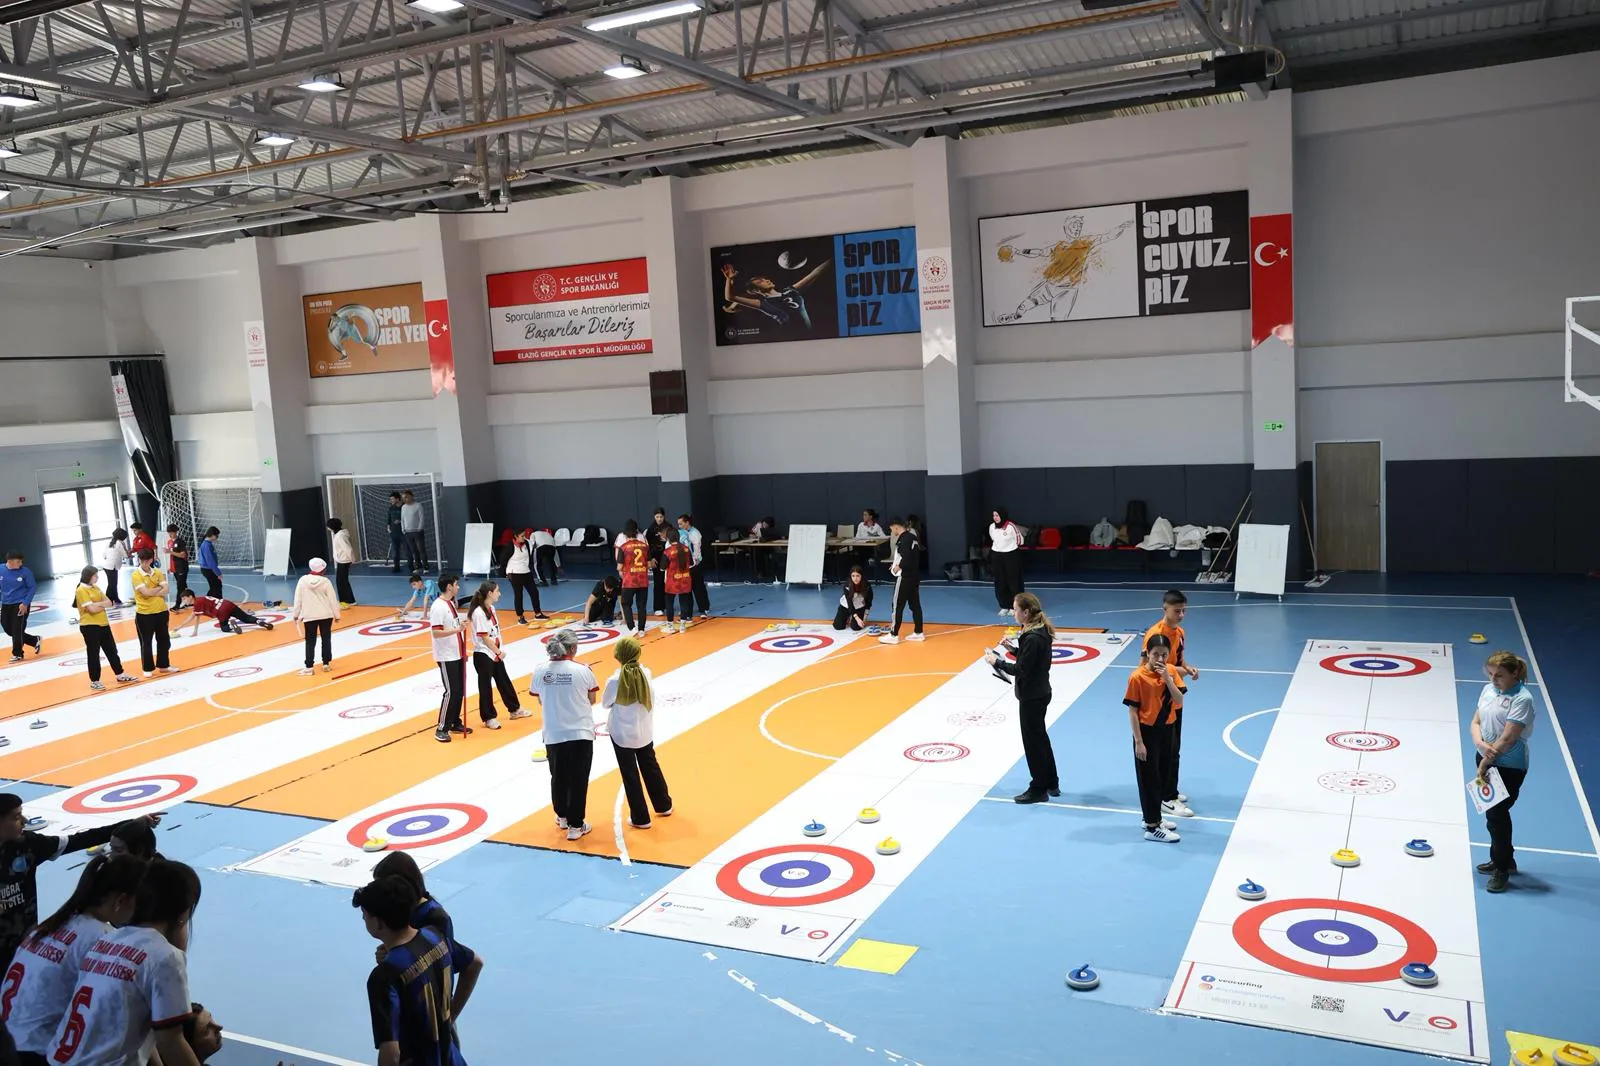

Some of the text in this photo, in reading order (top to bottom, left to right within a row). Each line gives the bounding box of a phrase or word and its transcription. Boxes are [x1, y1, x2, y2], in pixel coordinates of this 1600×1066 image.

[1142, 205, 1213, 239] SPOR
[843, 238, 900, 268] SPOR
[560, 272, 619, 285] T.C. GENÇLİK VE
[560, 281, 619, 294] SPOR BAKANLIĞI
[845, 268, 916, 298] CUYUZ
[1144, 273, 1189, 307] BİZ
[374, 306, 410, 327] SPOR
[505, 309, 566, 323] Sporcularımıza
[568, 309, 579, 317] ve
[846, 300, 883, 328] BİZ
[524, 316, 635, 341] Başarılar Dileriz
[518, 351, 539, 360] ELAZIĞ
[540, 348, 567, 358] GENÇLİK
[568, 348, 577, 356] VE
[578, 347, 594, 355] SPOR
[603, 342, 646, 353] MÜDÜRLÜĞÜ
[633, 548, 643, 566] 2
[53, 985, 94, 1065] 6
